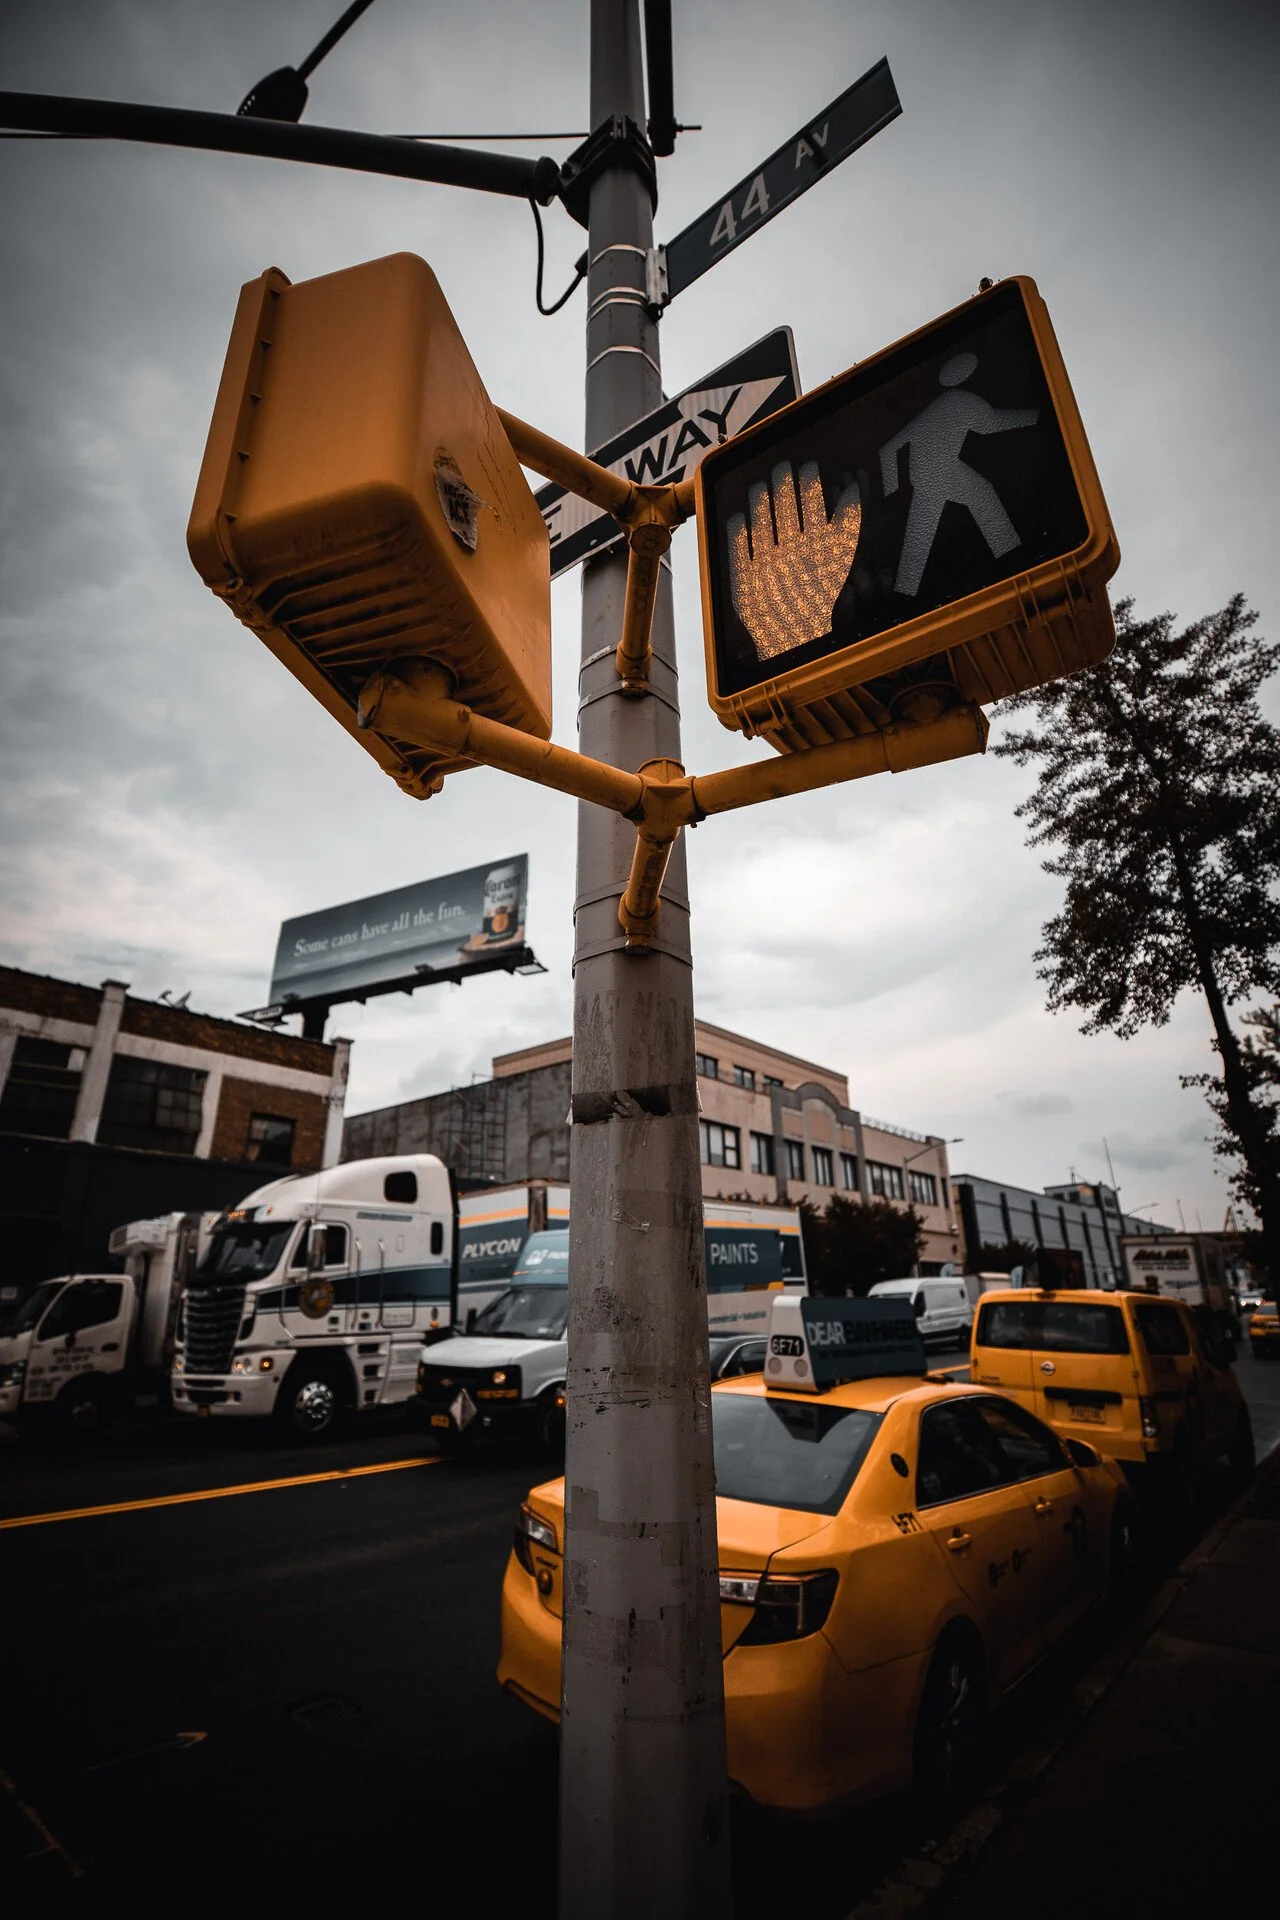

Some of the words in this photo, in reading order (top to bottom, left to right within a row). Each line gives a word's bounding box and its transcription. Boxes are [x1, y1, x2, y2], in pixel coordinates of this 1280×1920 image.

[709, 172, 771, 247] 44
[624, 386, 743, 486] WAY
[294, 938, 327, 957] Some
[331, 930, 358, 948] cans
[361, 922, 389, 941] have
[392, 911, 408, 932] all
[414, 907, 433, 927] the
[438, 901, 466, 922] fun.
[463, 1238, 522, 1260] PLYCON
[710, 1243, 759, 1265] PAINTS
[806, 1321, 847, 1346] DEAR
